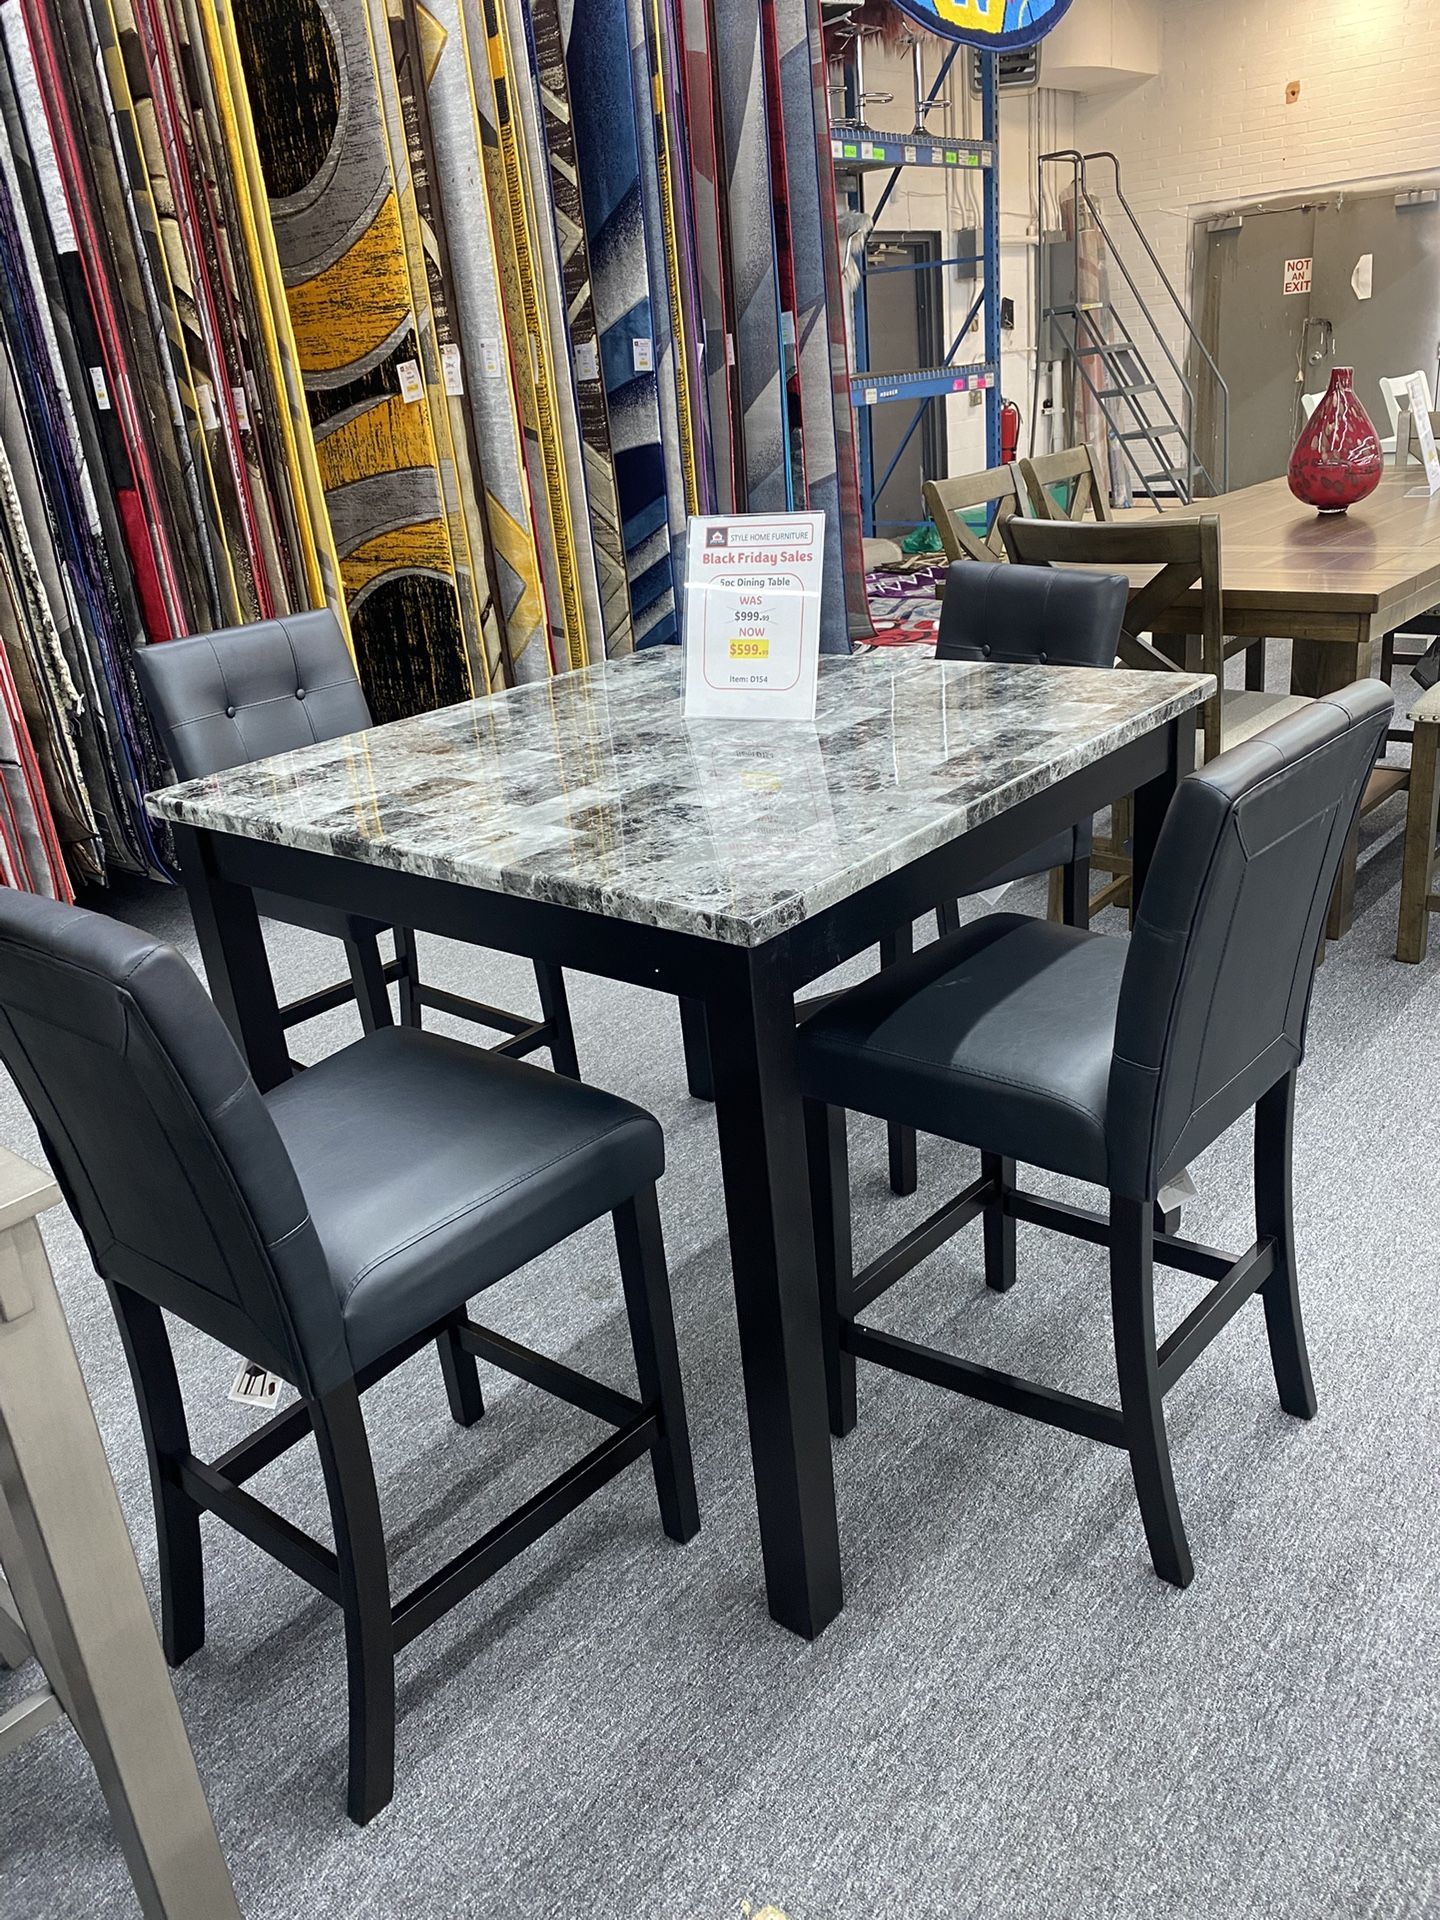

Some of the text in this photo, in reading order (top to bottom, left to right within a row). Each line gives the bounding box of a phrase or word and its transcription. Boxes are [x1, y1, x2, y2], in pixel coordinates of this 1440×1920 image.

[1287, 259, 1311, 272] NOT
[1292, 271, 1305, 281] AN
[1285, 280, 1311, 293] EXIT
[730, 531, 809, 542] STYLE HOME FURNITURE
[702, 550, 813, 567] Black Friday Sales
[737, 577, 765, 588] Dining
[767, 577, 791, 586] Table
[739, 595, 763, 605] WAS
[739, 627, 765, 637] NOW
[729, 675, 768, 683] Item: D154
